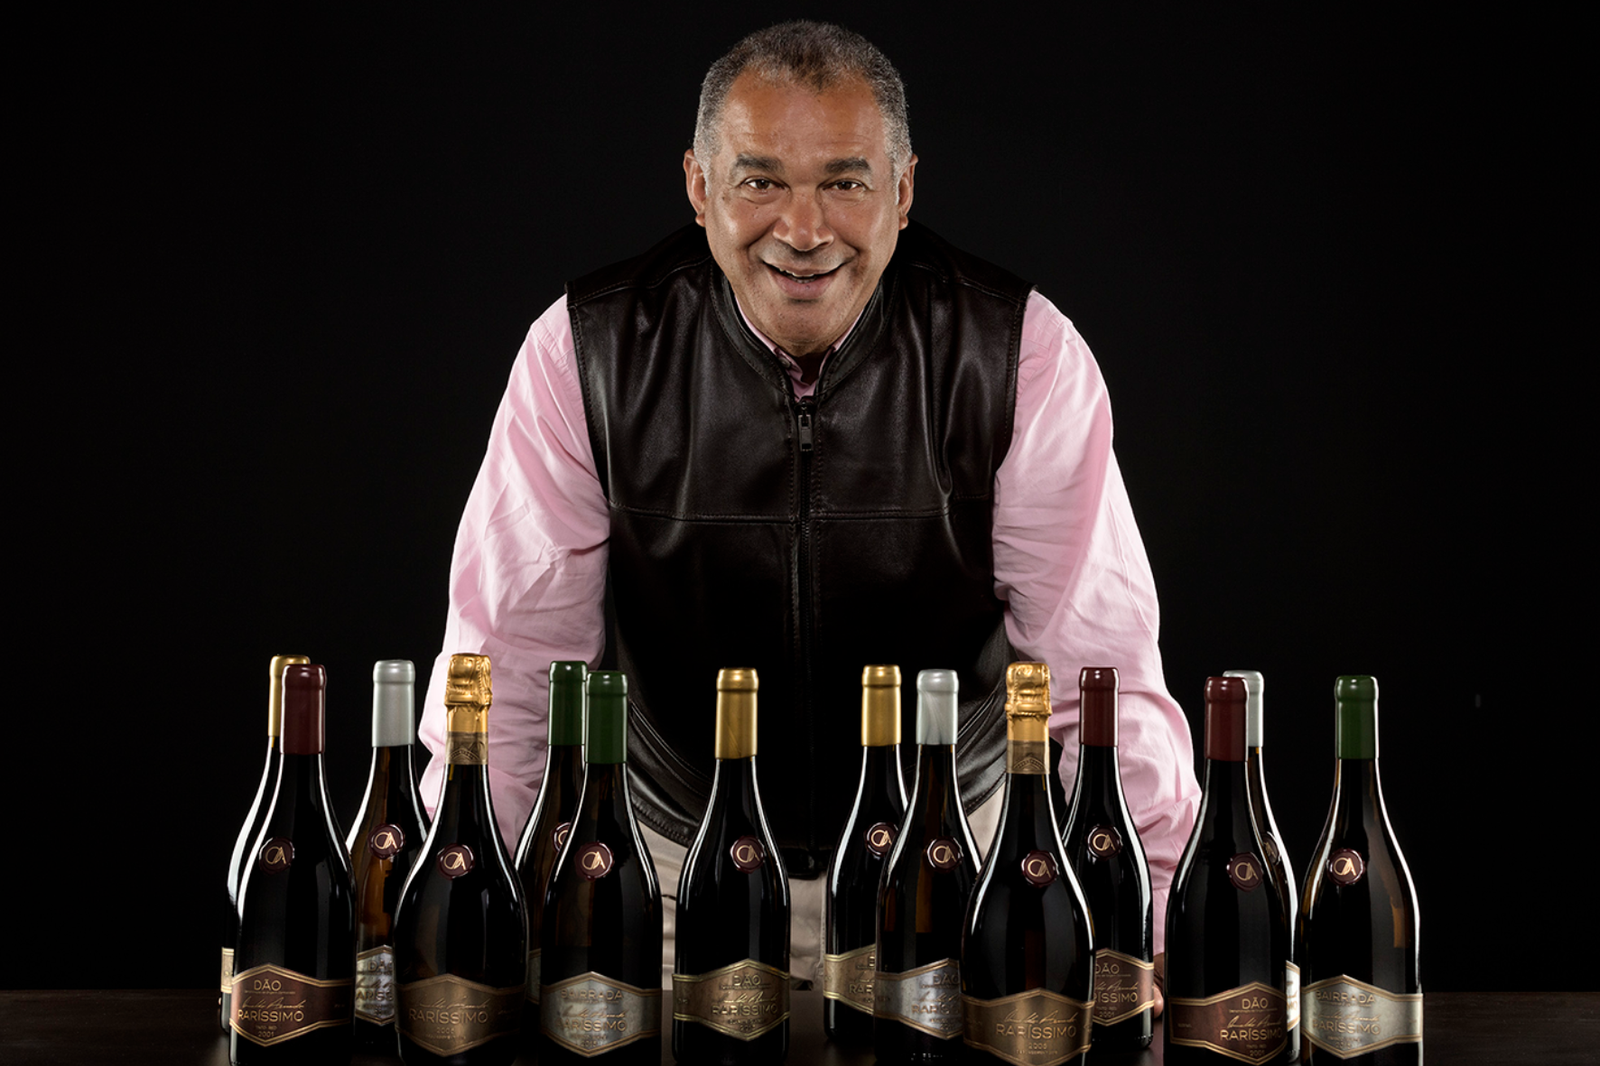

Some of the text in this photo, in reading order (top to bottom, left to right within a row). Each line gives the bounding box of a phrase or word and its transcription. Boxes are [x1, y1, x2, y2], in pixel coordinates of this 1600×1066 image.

[254, 979, 281, 991] DÃO
[561, 989, 623, 1001] BAIRRADA
[1316, 991, 1375, 1004] BAIRRADA
[1242, 997, 1268, 1009] DÃO
[238, 1009, 304, 1022] RARÍSSIMO
[408, 1008, 488, 1024] RARÍSSIMO
[995, 1023, 1076, 1039] RARÍSSIMO
[1312, 1019, 1380, 1035] RARÍSSIMO
[1221, 1028, 1282, 1041] RARÍSSIMO
